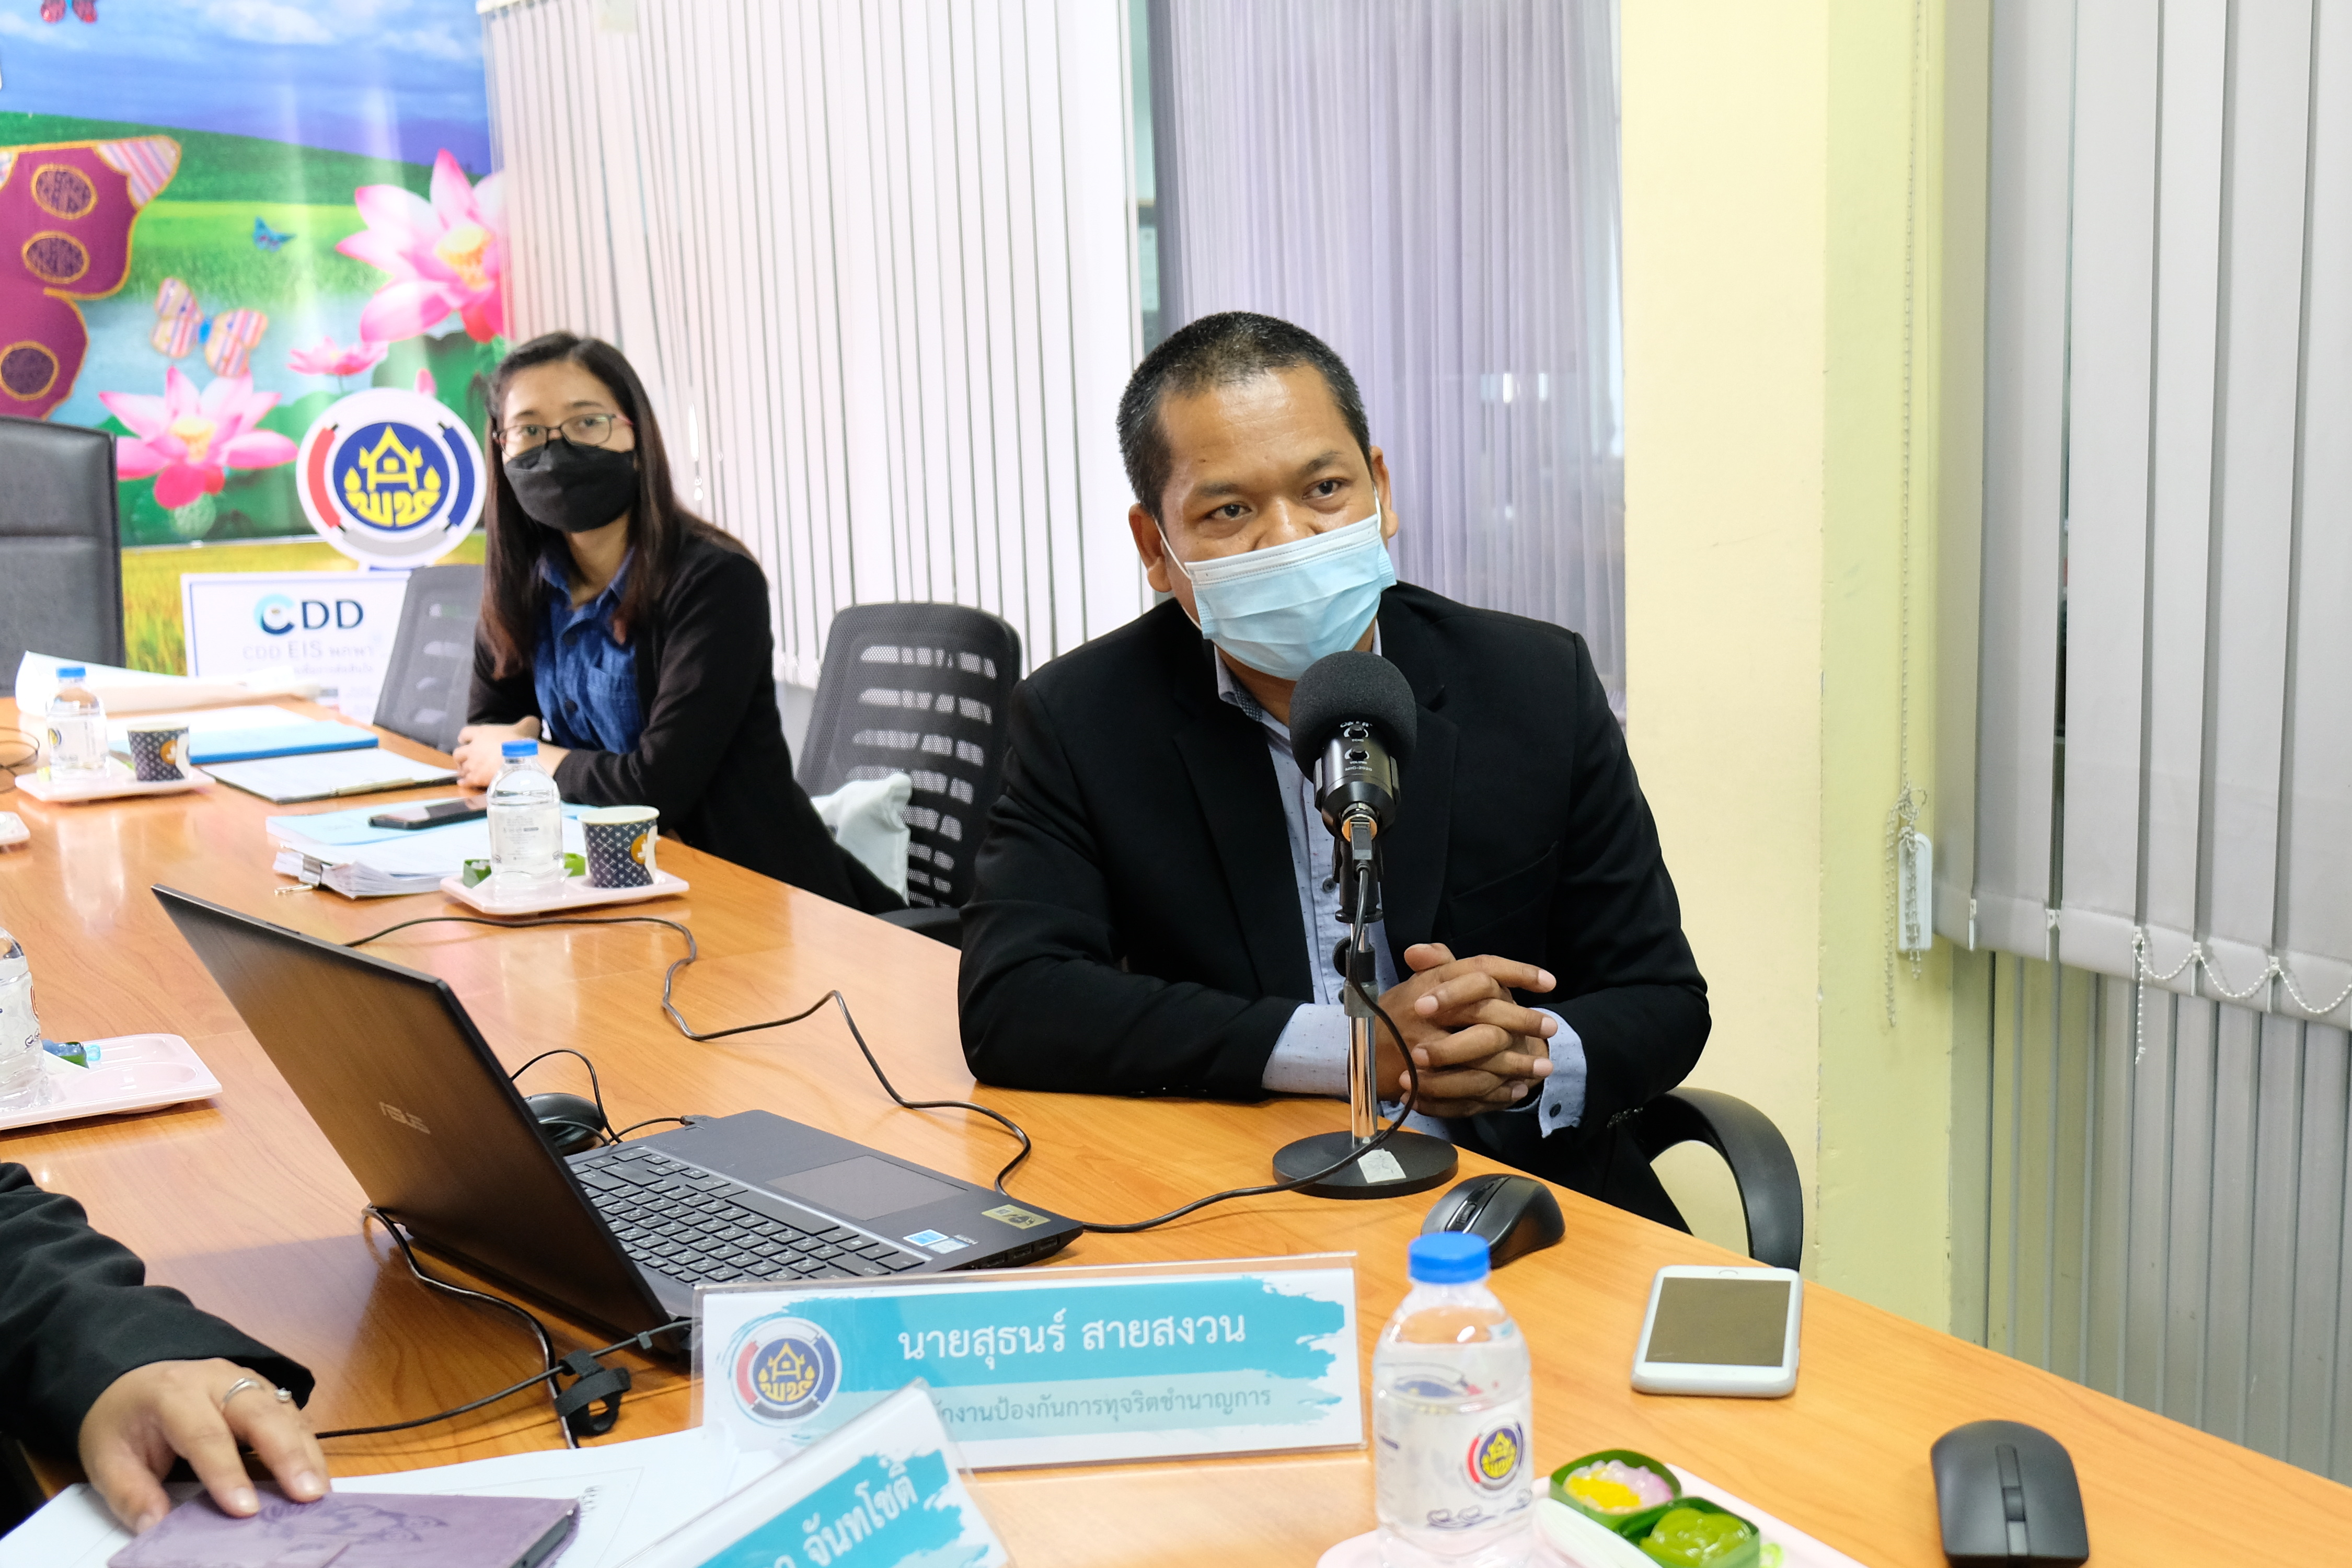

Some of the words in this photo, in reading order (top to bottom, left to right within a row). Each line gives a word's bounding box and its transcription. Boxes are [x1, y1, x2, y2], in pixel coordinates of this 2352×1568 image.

[898, 1307, 1067, 1369] นายสุธนร์
[1081, 1314, 1246, 1351] สายสงวน
